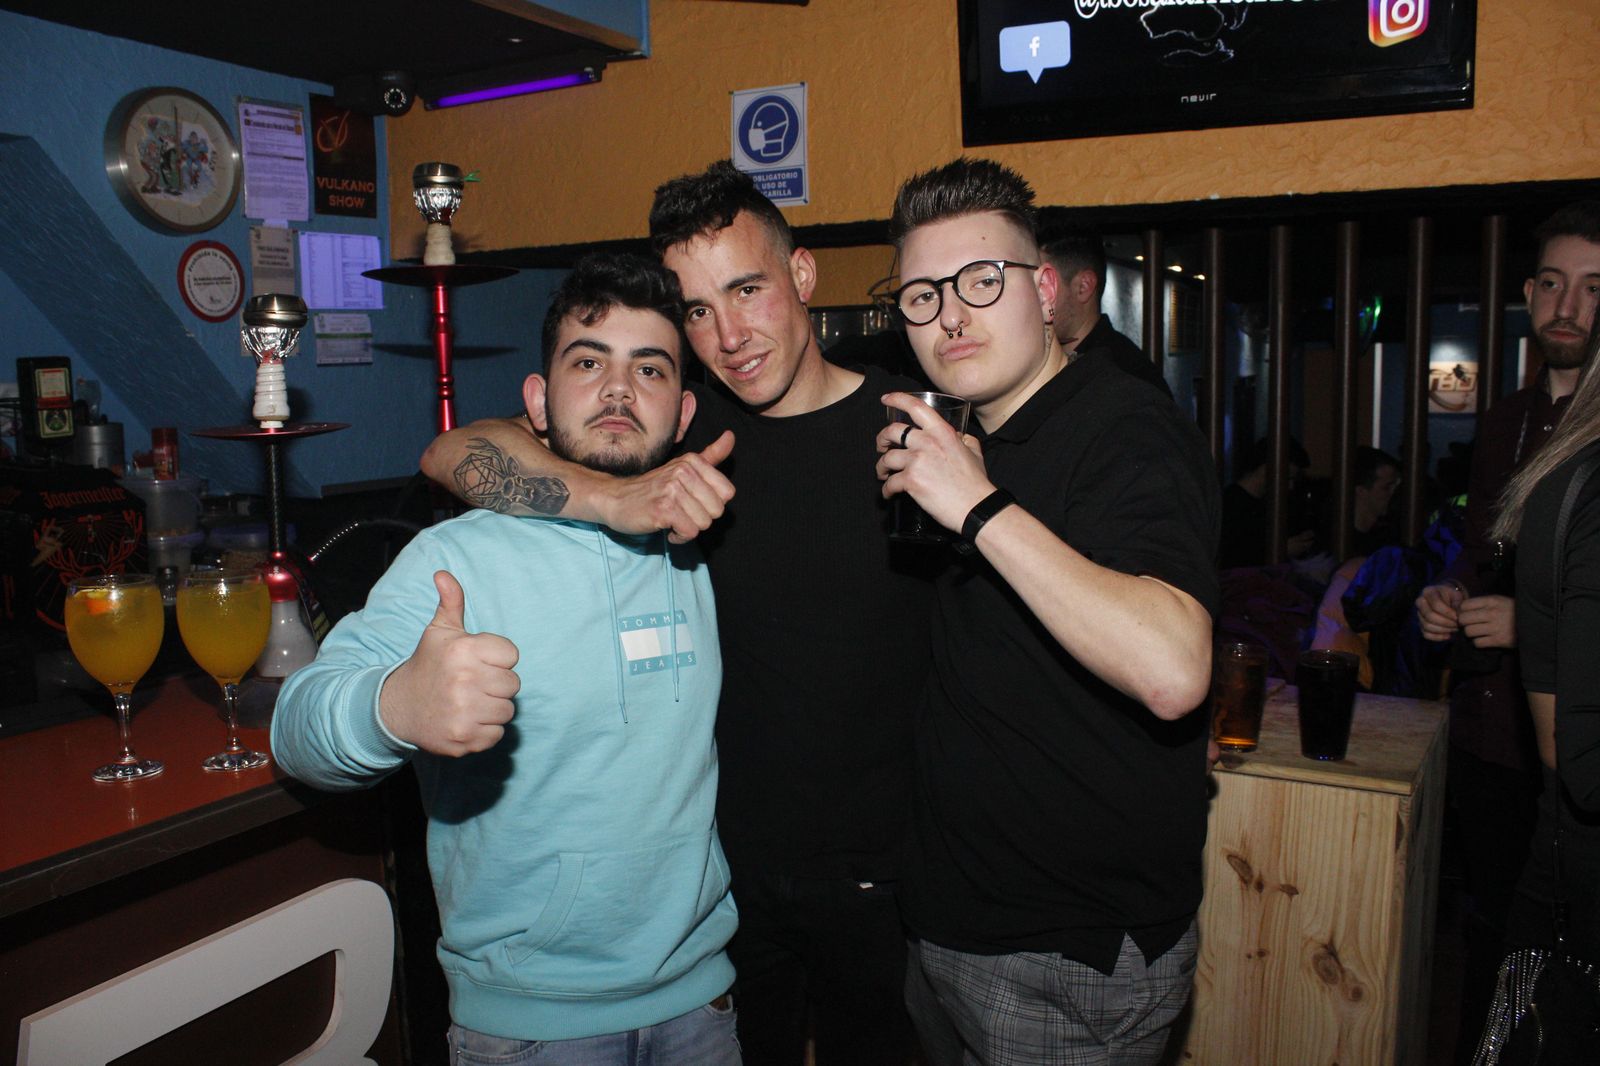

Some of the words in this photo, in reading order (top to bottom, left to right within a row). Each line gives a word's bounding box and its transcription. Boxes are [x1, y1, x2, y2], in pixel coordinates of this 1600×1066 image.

[753, 172, 798, 182] OBLIGATORIO
[316, 176, 375, 193] VULKANO
[762, 182, 776, 190] USO
[777, 181, 787, 189] DE
[328, 194, 366, 208] SHOW
[622, 613, 682, 629] TOMMY
